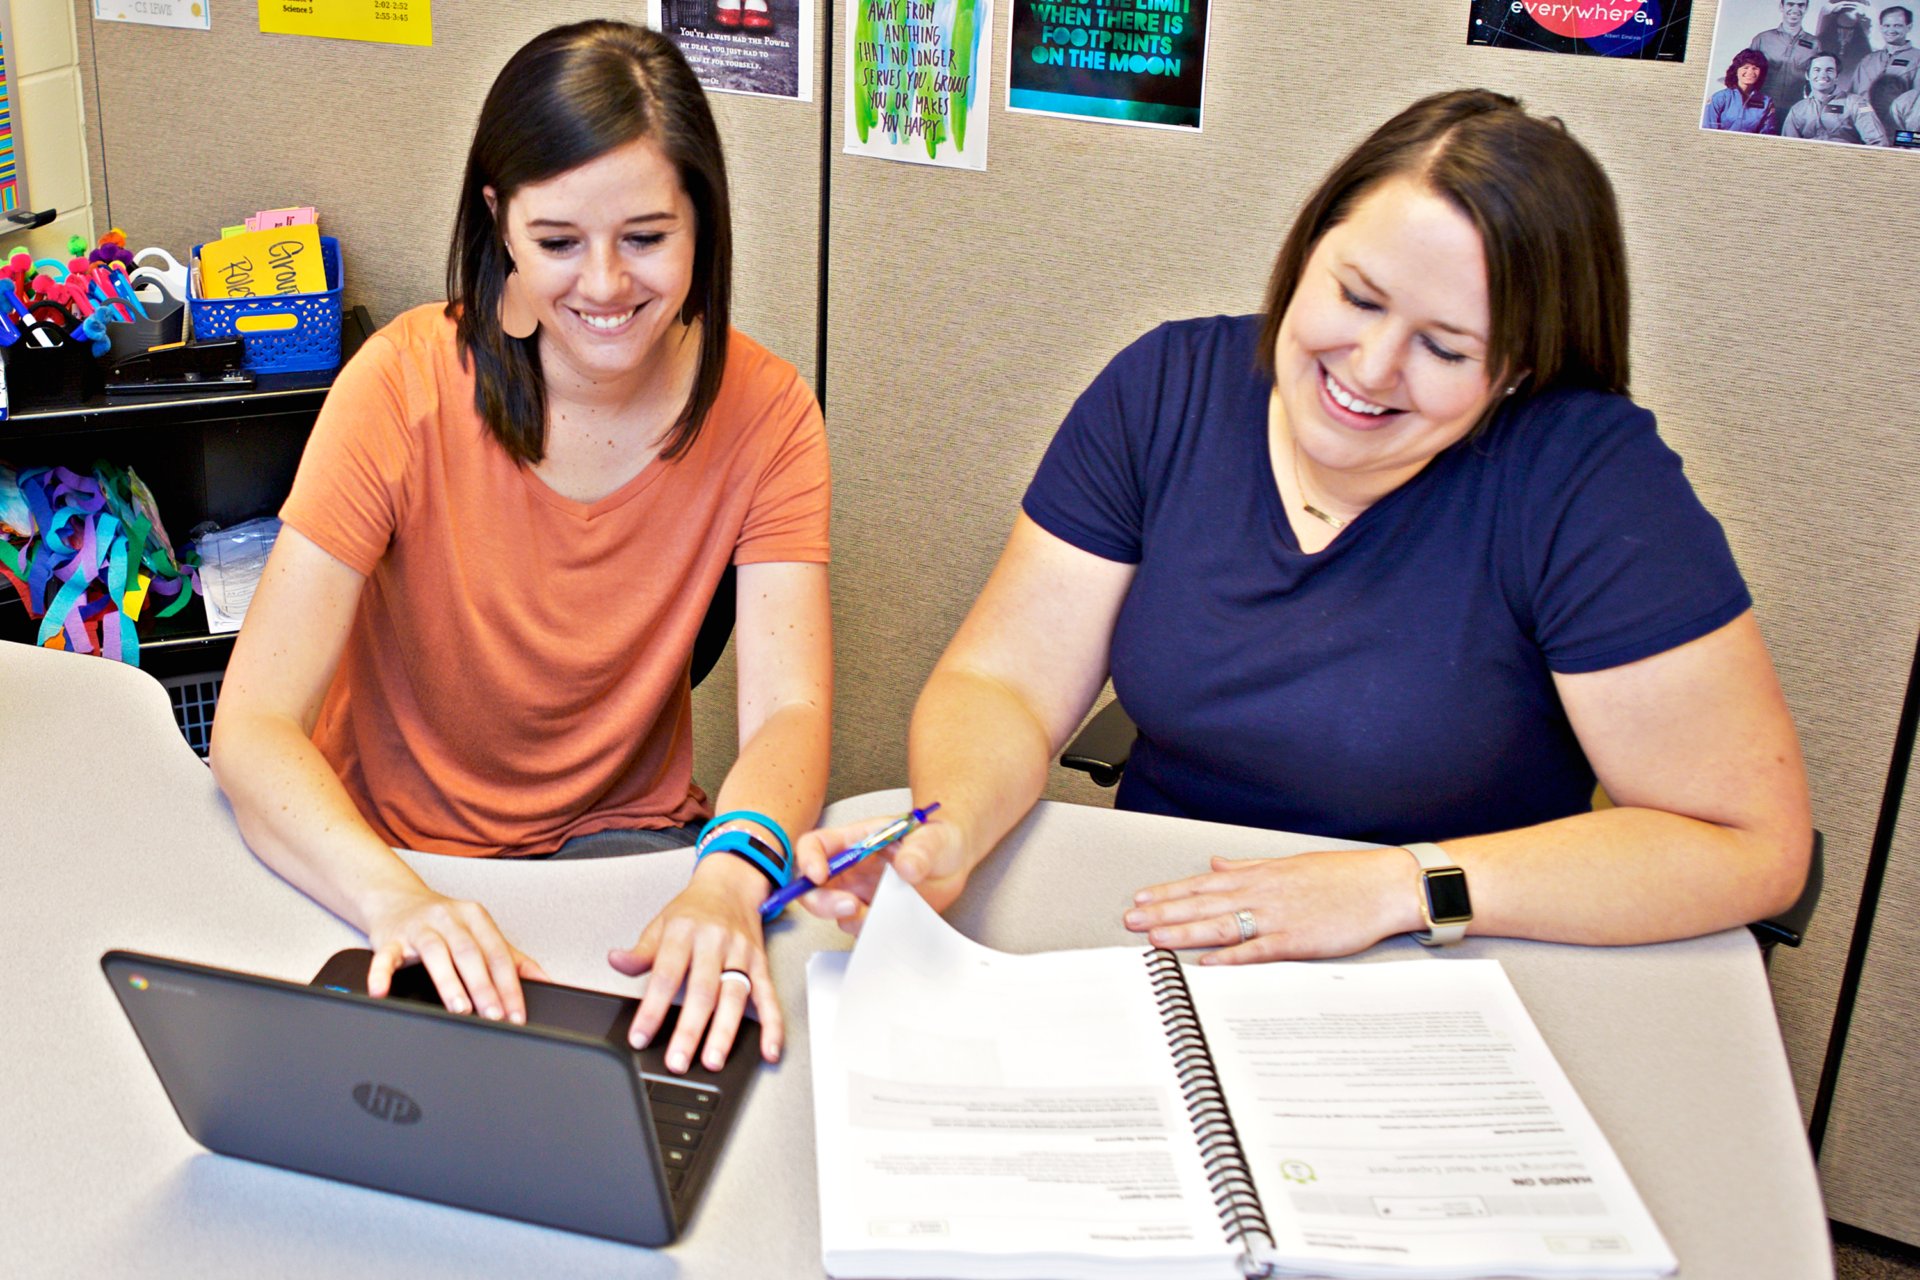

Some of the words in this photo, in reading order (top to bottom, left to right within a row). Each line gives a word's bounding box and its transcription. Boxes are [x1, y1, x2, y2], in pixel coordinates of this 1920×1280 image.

[150, 3, 172, 16] LEWIS
[283, 4, 307, 13] Science
[309, 6, 313, 14] 5
[375, 12, 408, 21] 2:55-3:45
[868, 0, 900, 22] AWAY
[906, 1, 935, 23] FROM
[1031, 4, 1091, 27] WHEN
[1097, 9, 1159, 32] THERE
[1164, 14, 1183, 35] IS
[885, 24, 940, 46] ANYTHING
[1042, 26, 1172, 55] FOOTPRINTS
[726, 60, 762, 70] YOURSELF.
[759, 51, 768, 59] TO
[859, 42, 884, 64] THAT
[891, 46, 908, 66] NO
[911, 48, 957, 70] LONGER
[1031, 45, 1064, 66] ON
[1069, 49, 1105, 70] THE
[1109, 53, 1181, 78] MOON
[863, 67, 902, 89] SERVES
[934, 72, 971, 98] GROWS
[868, 90, 887, 110] YOU
[895, 93, 909, 111] OR
[915, 96, 949, 116] MAKES
[881, 112, 899, 133] YOU
[904, 115, 940, 141] HAPPY
